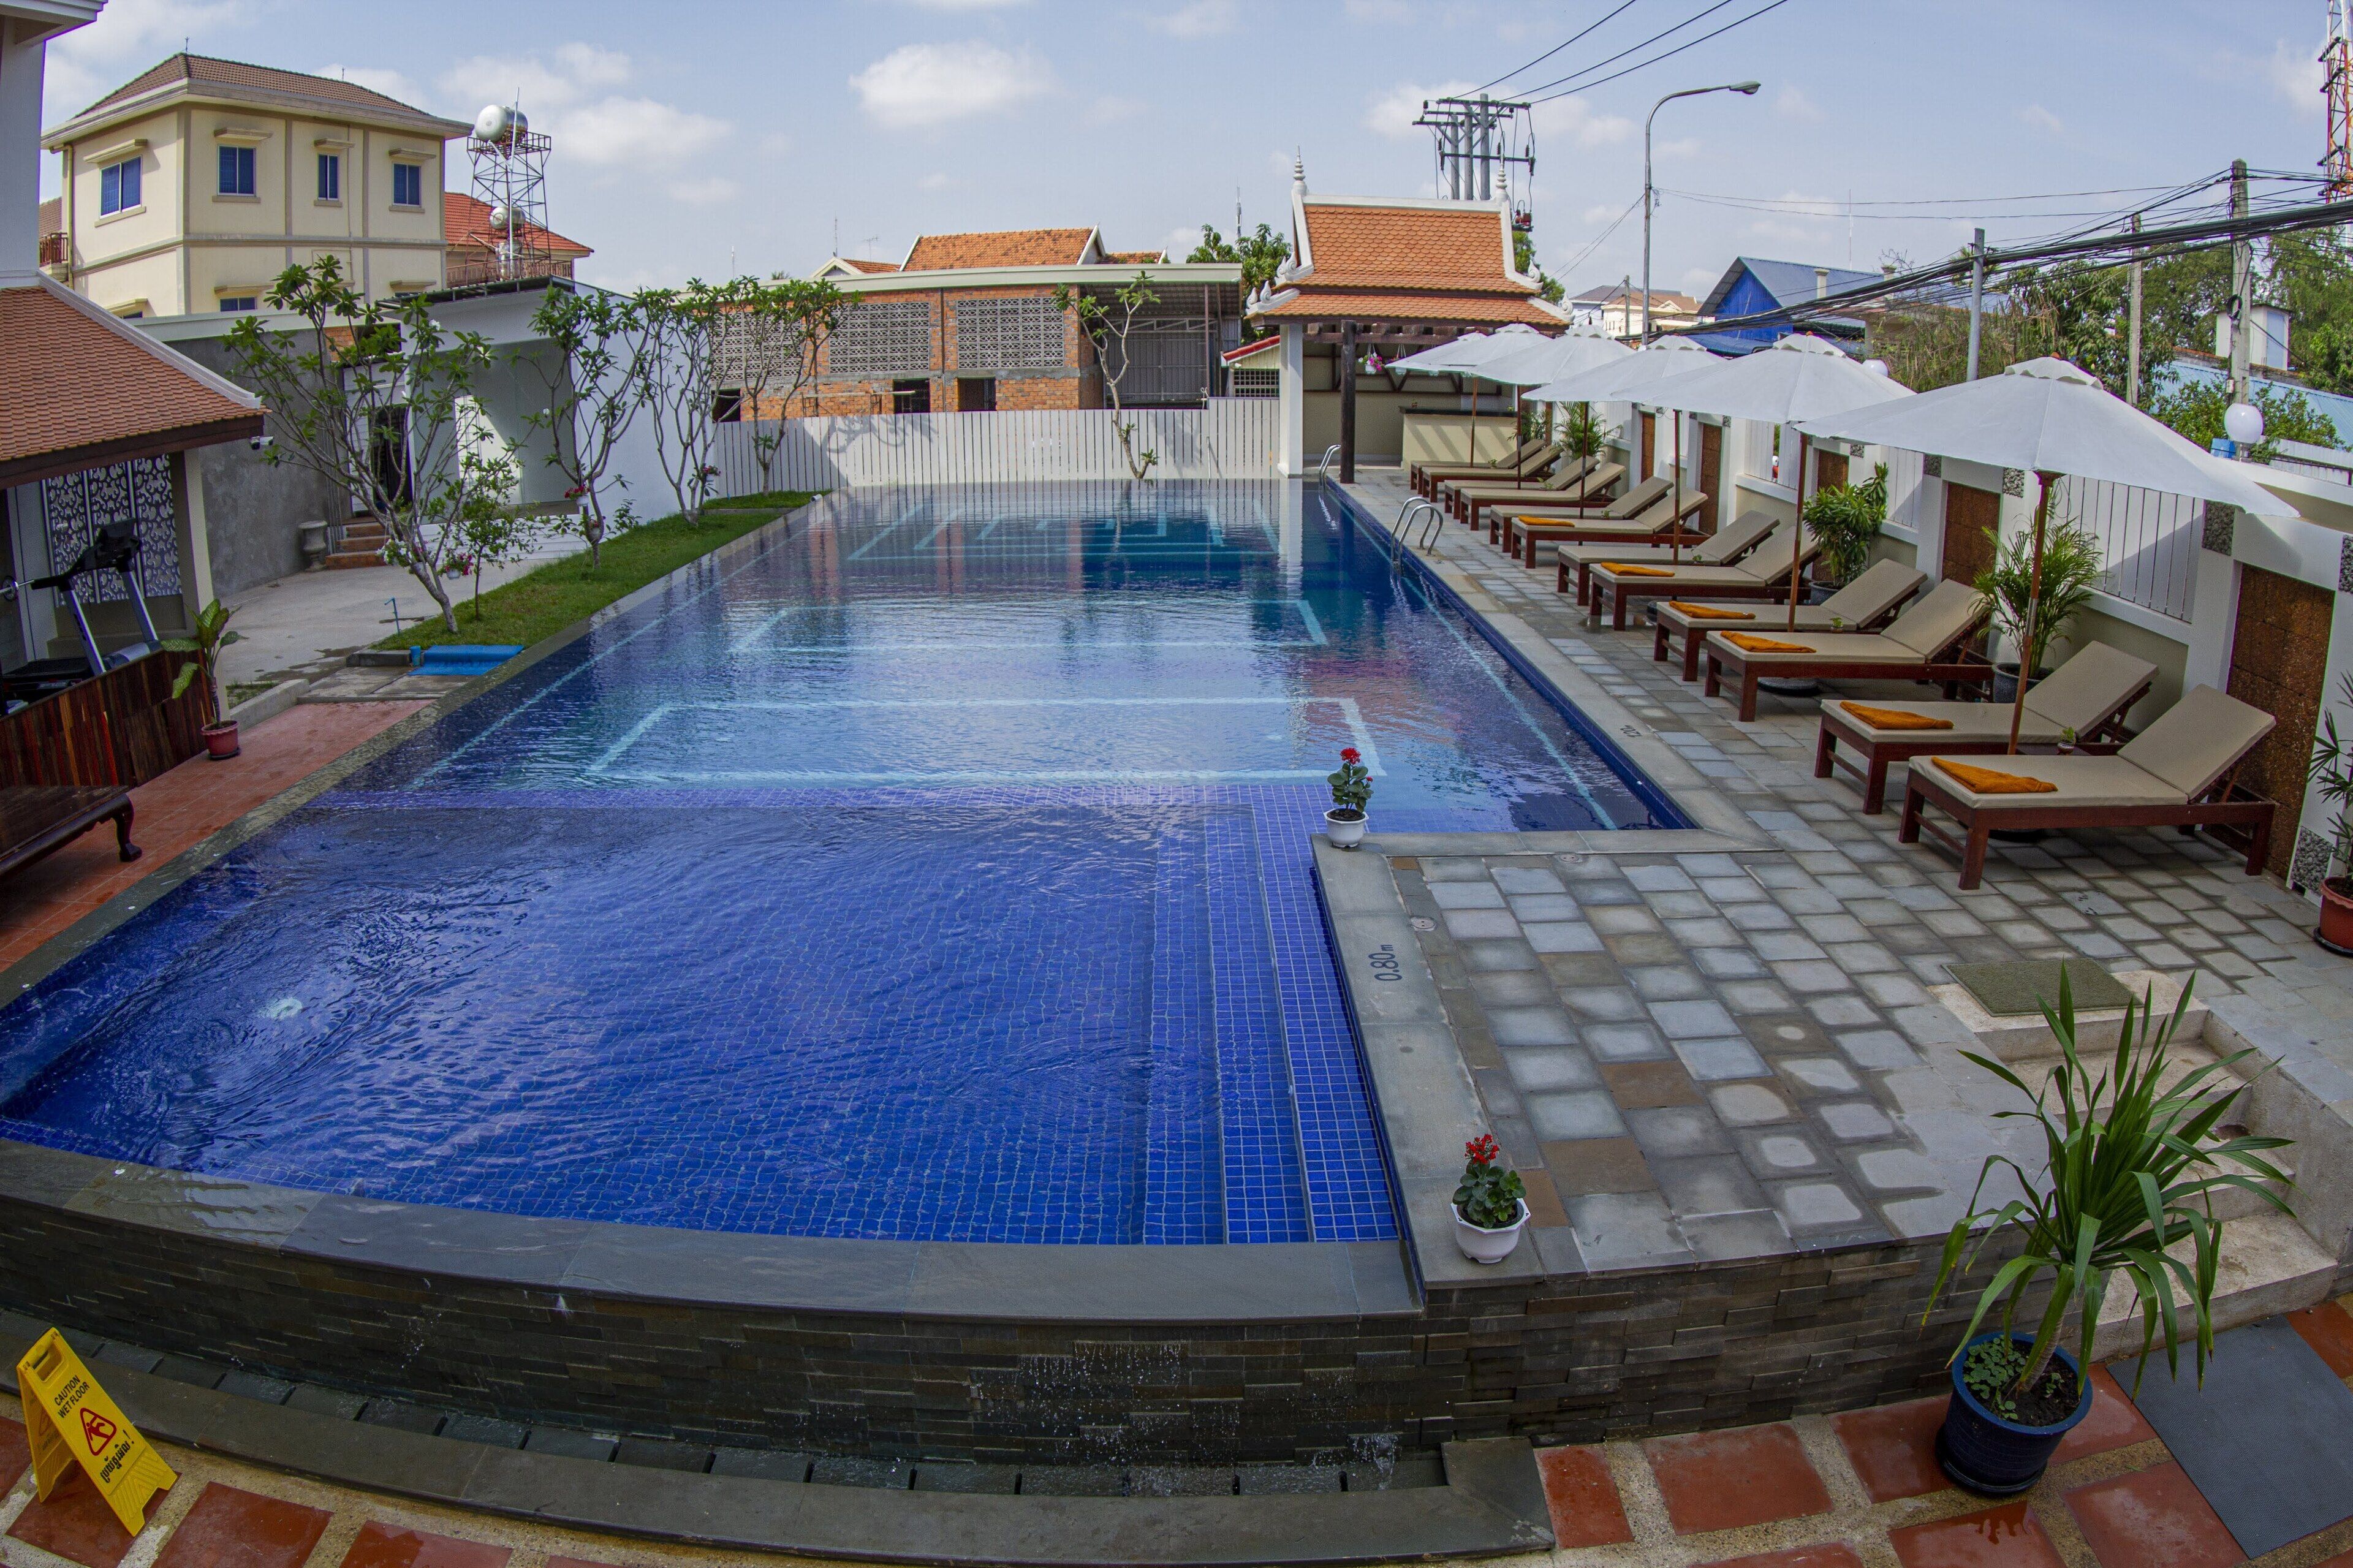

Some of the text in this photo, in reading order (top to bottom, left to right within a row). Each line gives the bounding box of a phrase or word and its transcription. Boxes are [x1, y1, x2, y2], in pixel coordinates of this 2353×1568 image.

[55, 1374, 80, 1406] CAUTION
[58, 1381, 90, 1418] WET FLOOR
